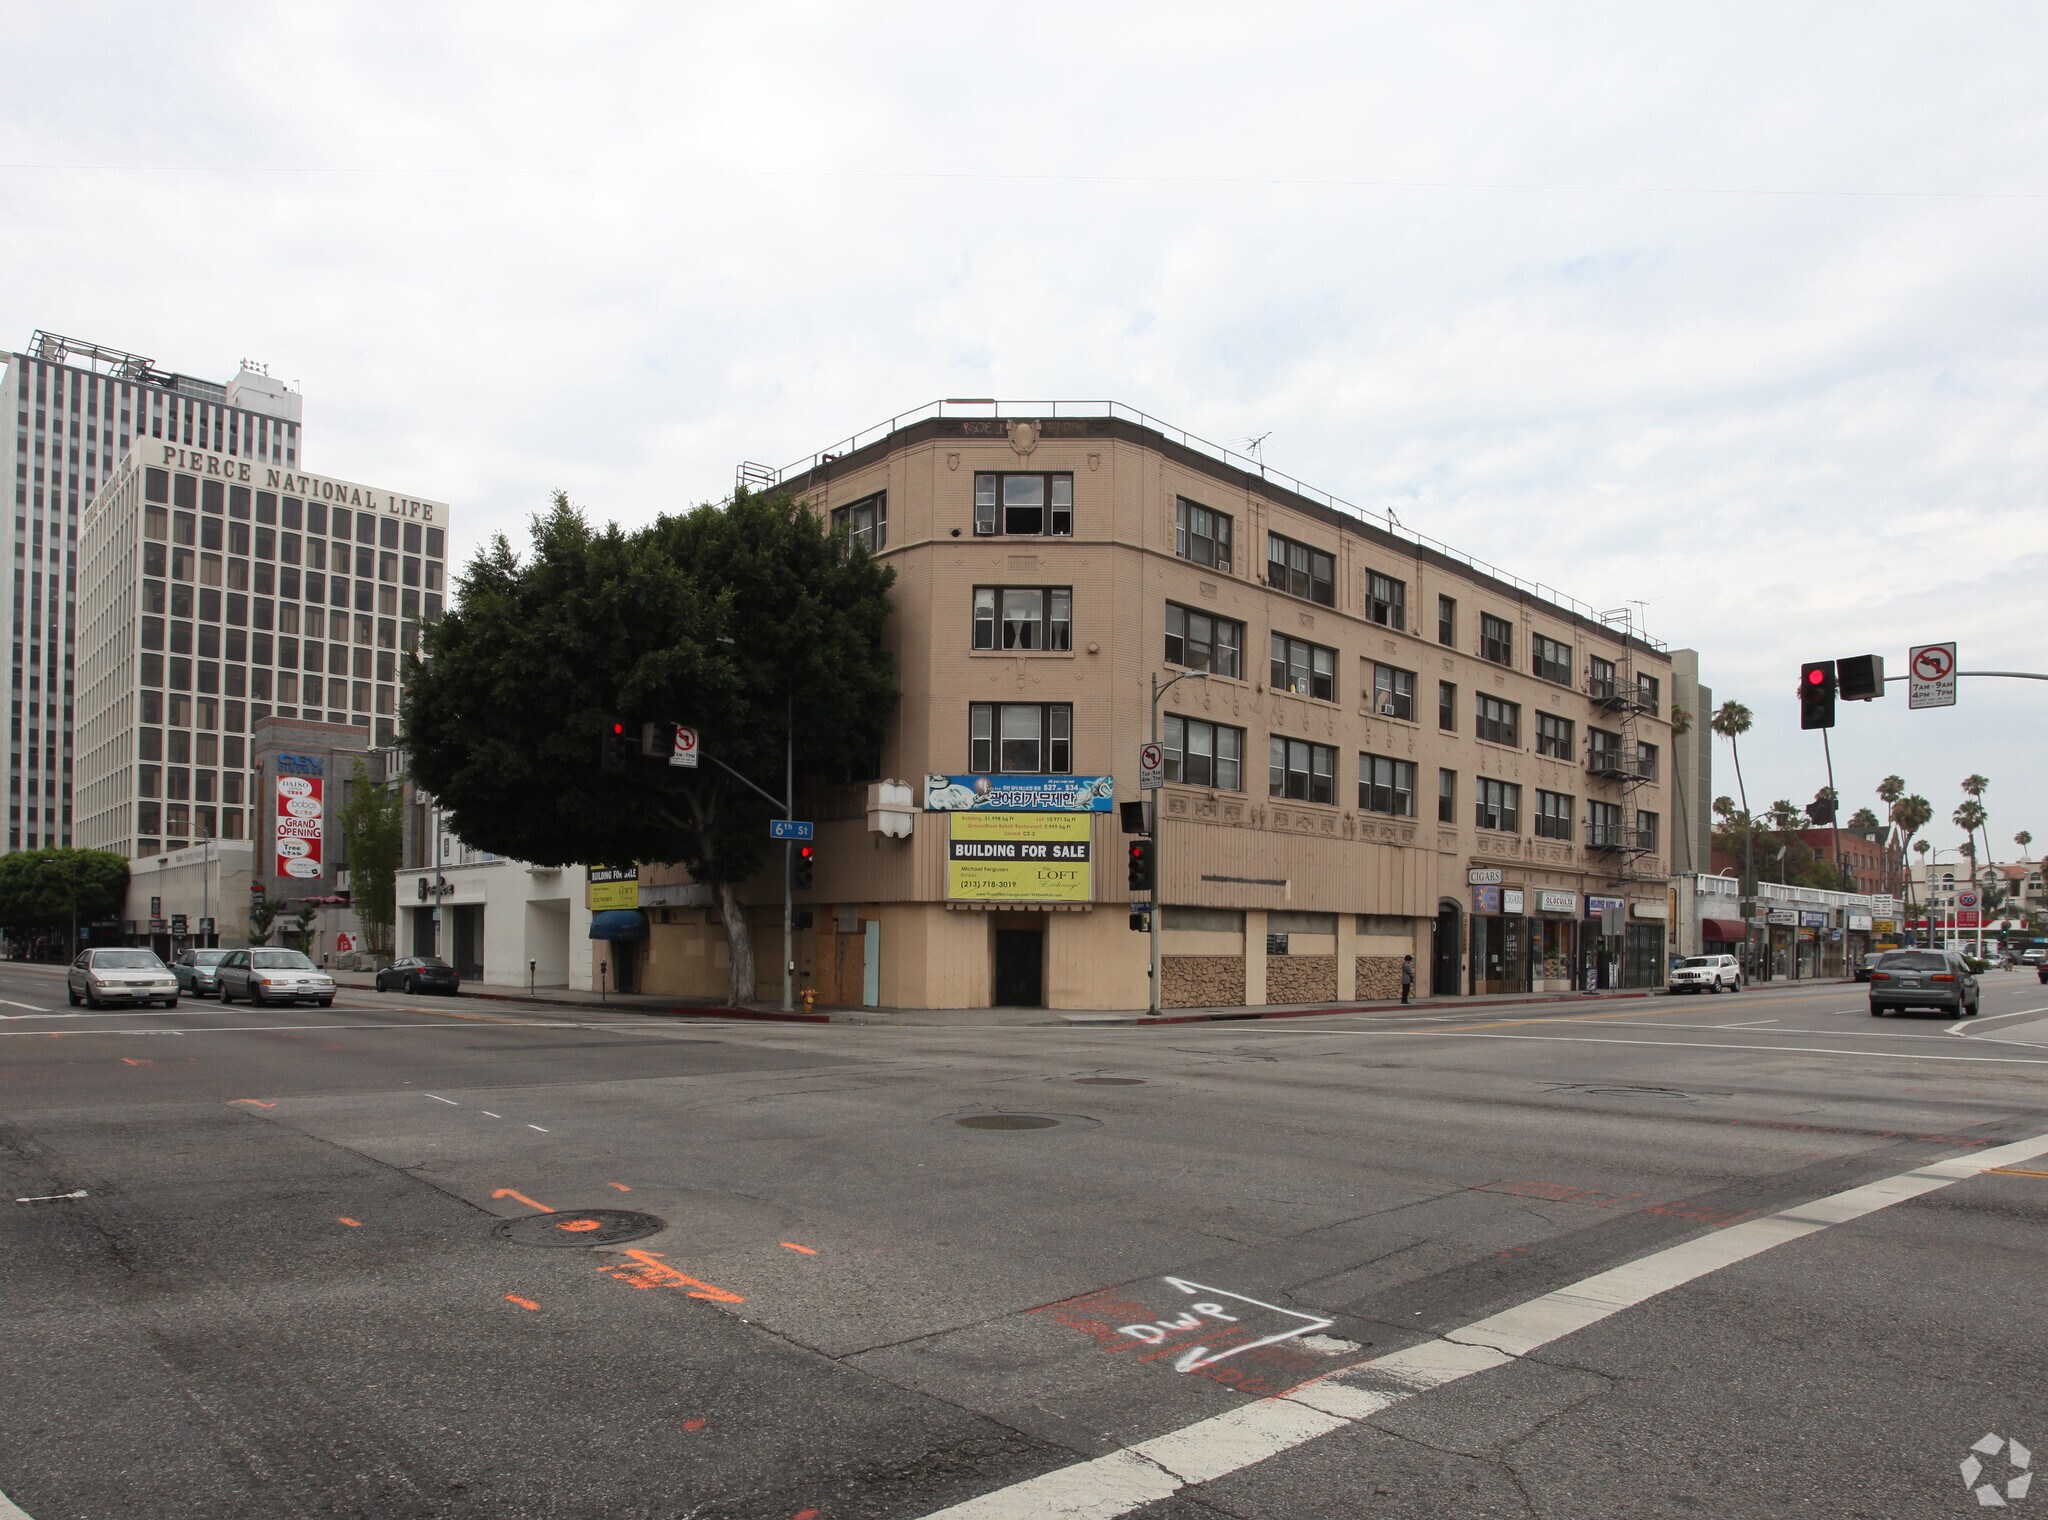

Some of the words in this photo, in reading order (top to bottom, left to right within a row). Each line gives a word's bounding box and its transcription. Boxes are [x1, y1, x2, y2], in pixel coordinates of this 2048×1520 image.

[163, 446, 251, 482] PIERCE
[267, 469, 377, 509] NATIONAL
[389, 496, 433, 521] LIFE
[279, 754, 324, 767] CGV
[279, 765, 324, 776] CINEMAS
[989, 791, 1038, 808] 광어회가
[1038, 791, 1076, 808] 무제한
[286, 818, 316, 829] GRAND
[278, 825, 321, 838] OPENING
[775, 823, 793, 836] 6th
[798, 826, 809, 836] St
[955, 844, 1016, 857] BUILDING
[1021, 845, 1047, 858] FOR
[1052, 846, 1085, 858] SALE
[591, 871, 612, 880] BUILDING
[1037, 870, 1078, 880] LOFT
[1470, 871, 1500, 882] CIGARS
[960, 881, 981, 889] (213)
[1504, 893, 1523, 905] CIGARS
[1961, 894, 1975, 904] 76
